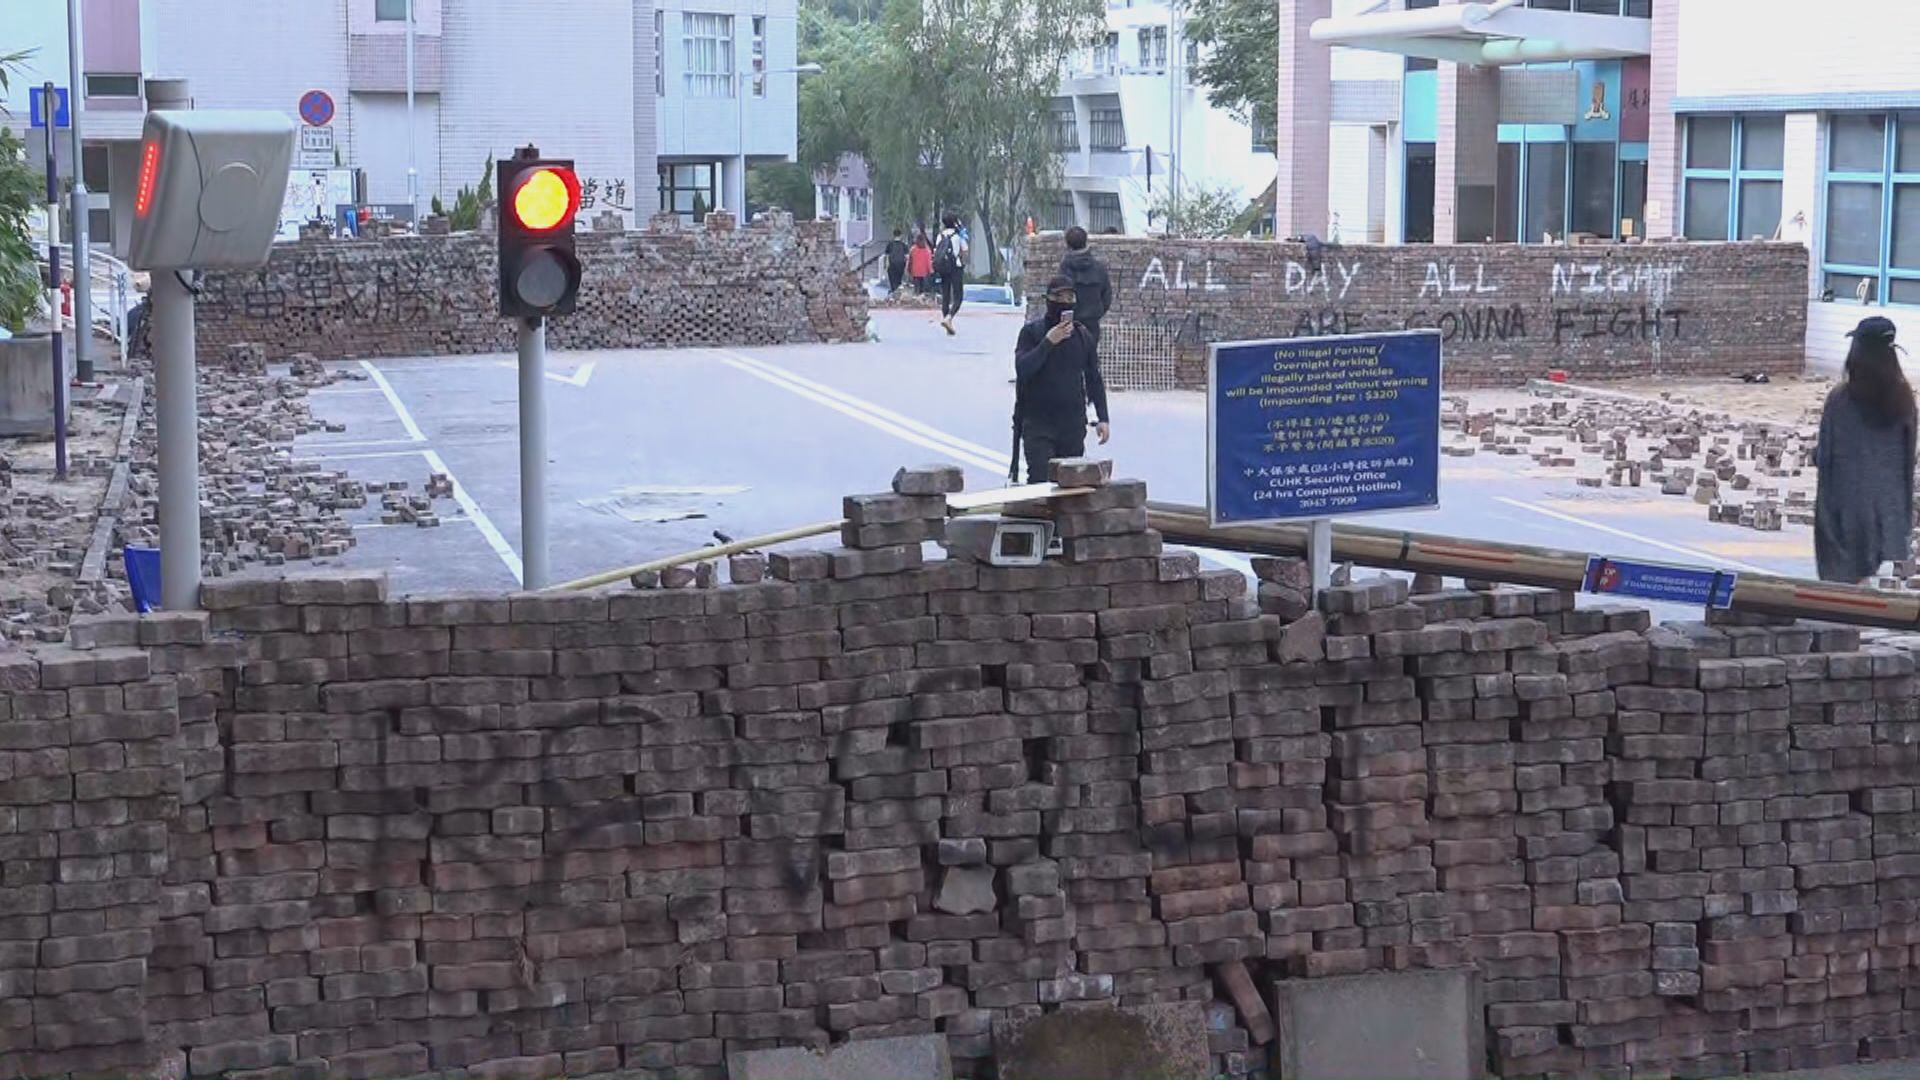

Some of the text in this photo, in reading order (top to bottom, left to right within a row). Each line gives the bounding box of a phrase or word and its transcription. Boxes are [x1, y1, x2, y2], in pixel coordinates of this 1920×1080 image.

[1138, 256, 1679, 301] ALL DAY ALL NIGHT
[1291, 308, 1367, 336] ARE
[1403, 303, 1528, 342] GONNA
[1554, 304, 1690, 344] FIGHT
[1274, 349, 1295, 361] (No
[1297, 347, 1332, 360] Illegal
[1334, 344, 1377, 357] Parking
[1273, 355, 1379, 372] Overnight Parking)
[1260, 366, 1394, 385] Illegally parked vehicles
[1225, 376, 1429, 399] will be impounded without warning
[1259, 393, 1334, 409] (Impounding
[1335, 391, 1356, 403] Fee
[1269, 470, 1387, 488] CUHK Security Office
[1253, 480, 1402, 501] (24 hrs Complaint Hotline)
